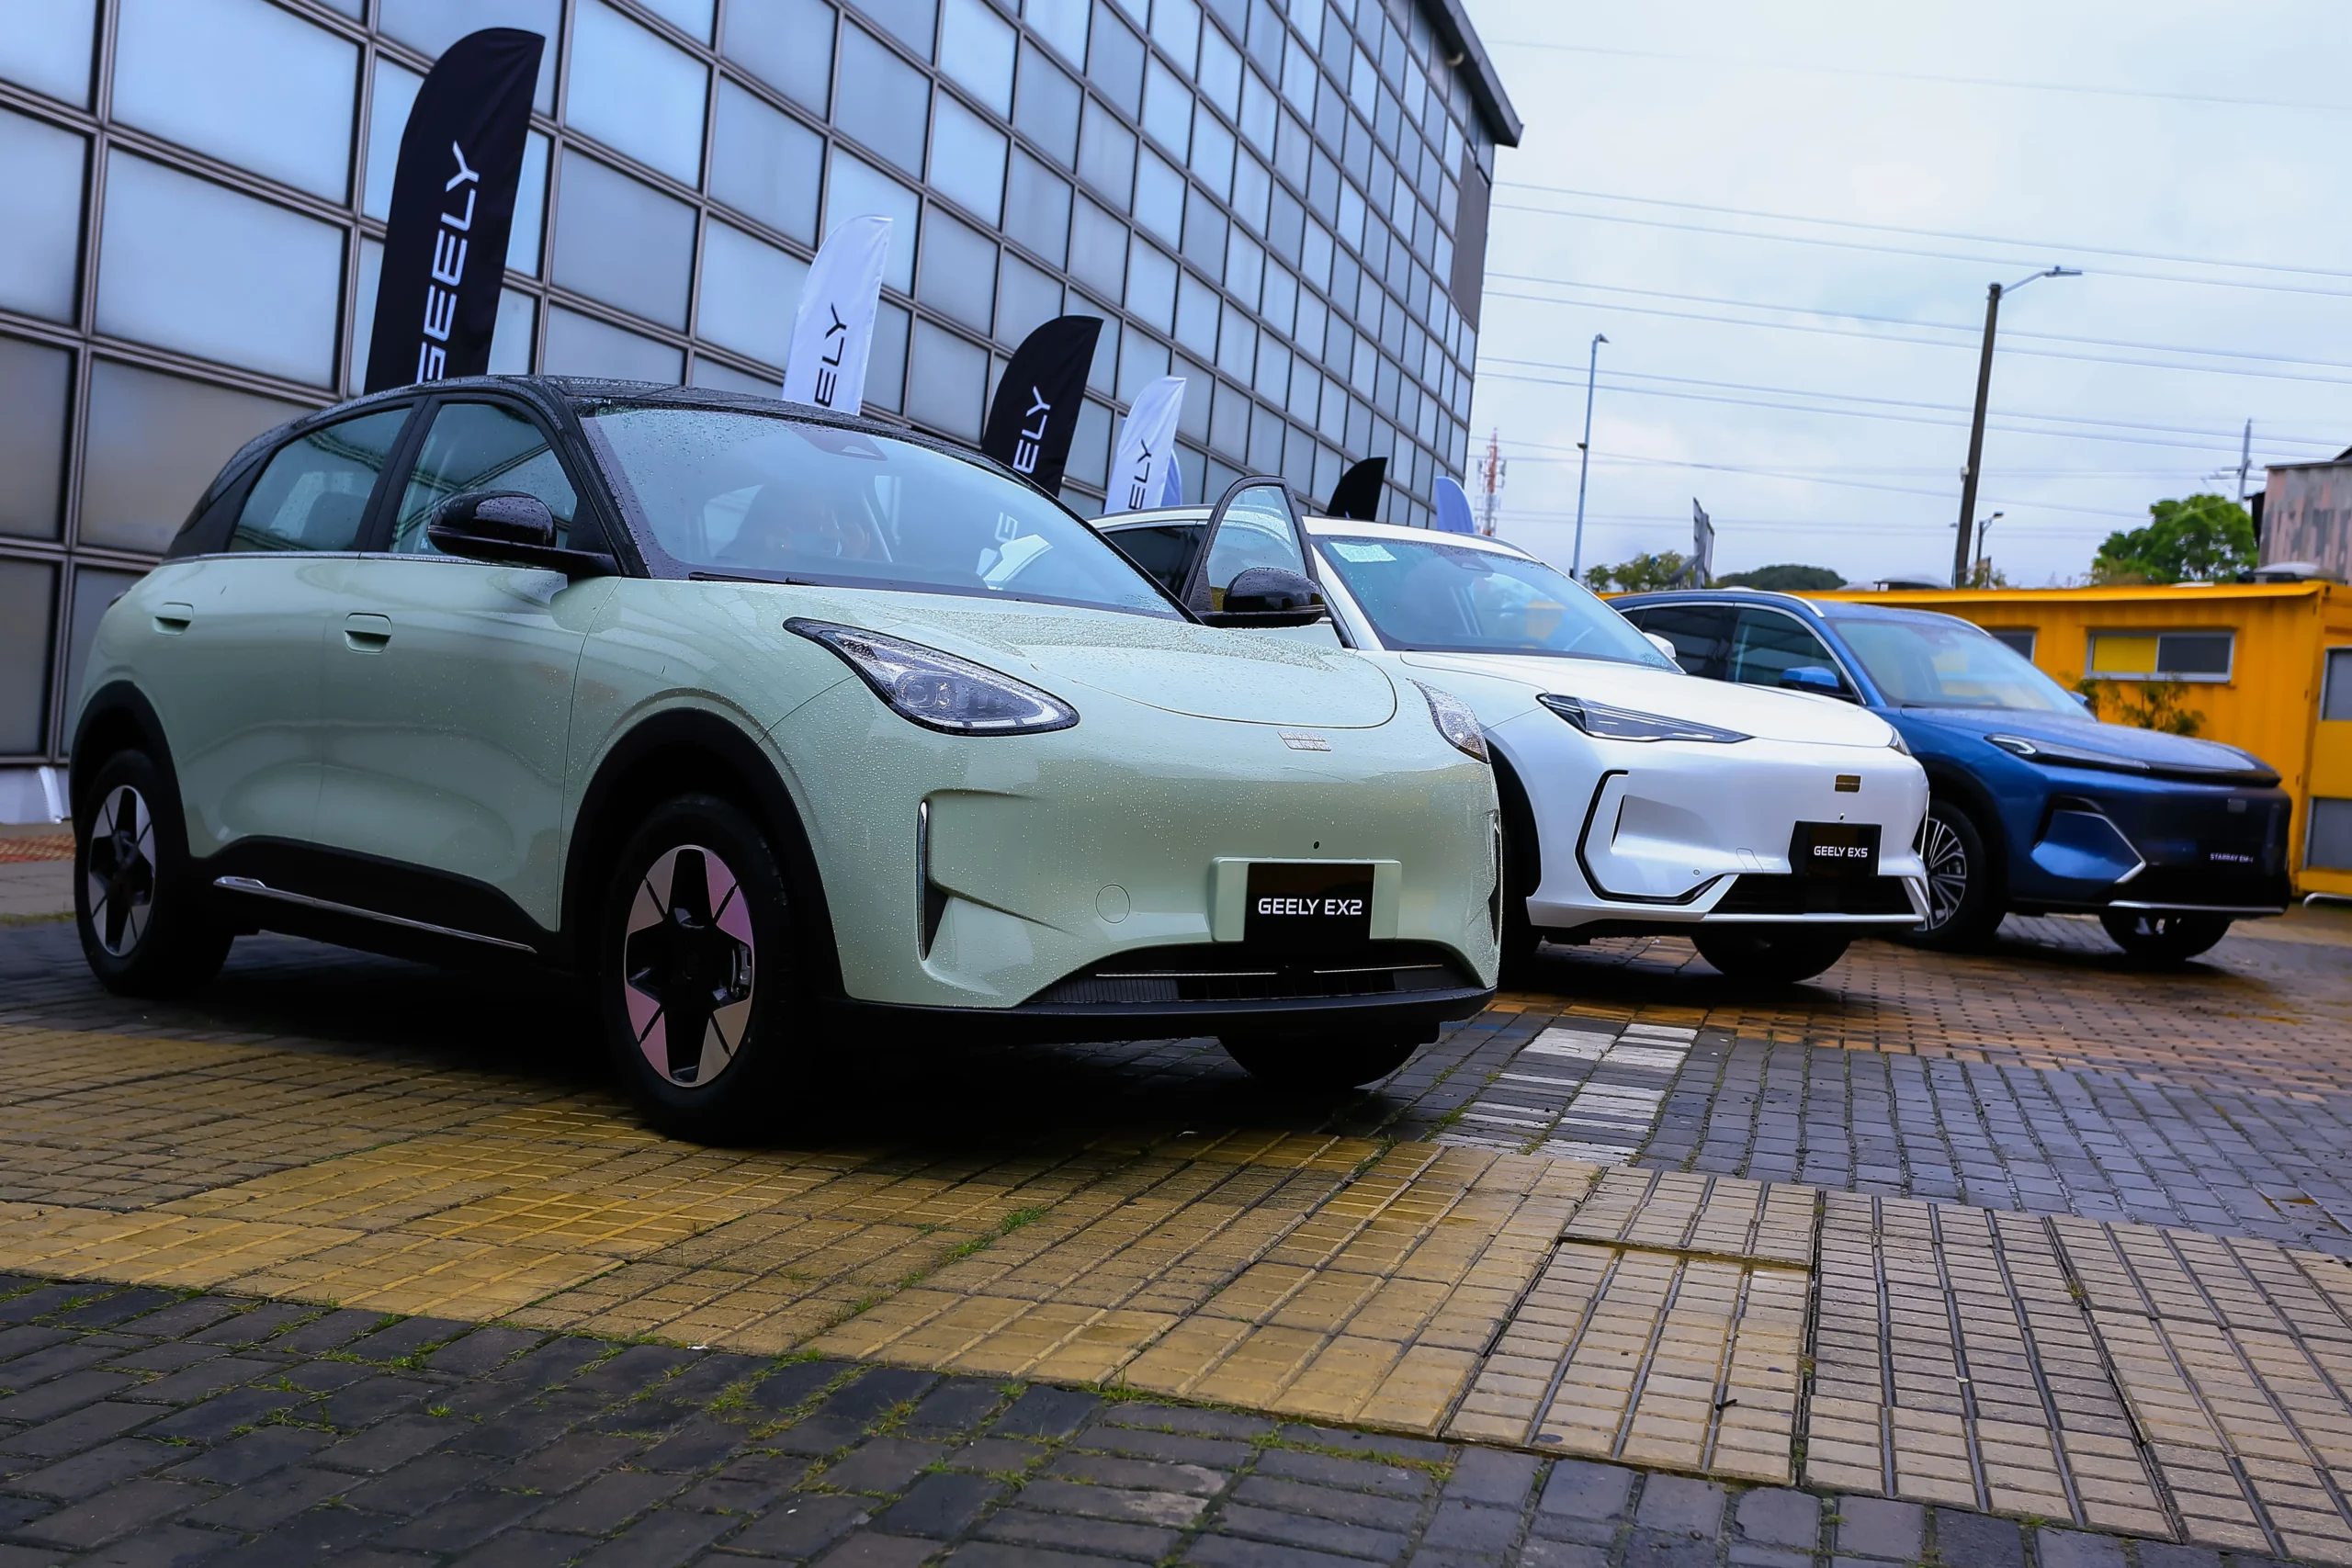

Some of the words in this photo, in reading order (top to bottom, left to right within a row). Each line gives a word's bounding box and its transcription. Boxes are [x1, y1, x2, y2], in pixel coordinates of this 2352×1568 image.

[416, 140, 480, 384] GEELY
[1814, 846, 1845, 857] GEELY
[1848, 847, 1868, 858] EX5
[1258, 897, 1320, 915] GEELY
[1324, 898, 1363, 915] EX2
